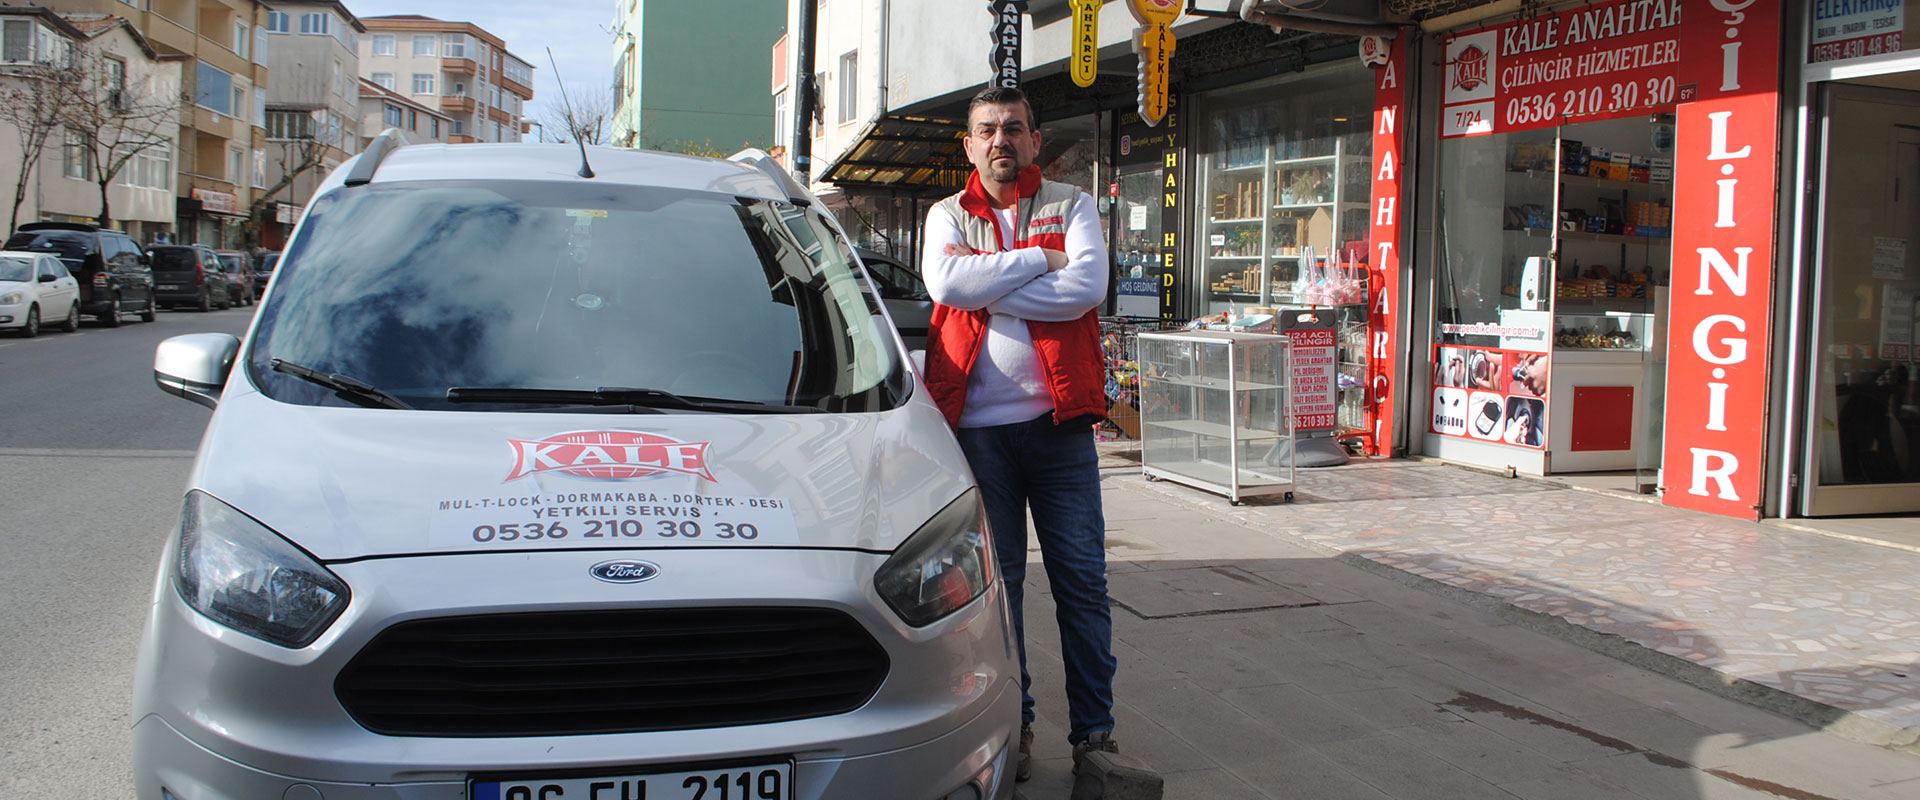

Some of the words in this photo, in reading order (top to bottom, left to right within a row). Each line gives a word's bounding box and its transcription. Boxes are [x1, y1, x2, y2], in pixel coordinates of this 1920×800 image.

[1002, 3, 1018, 88] ANAHTARC
[1083, 0, 1093, 73] AHTARCI
[1502, 17, 1560, 56] KALE
[1814, 43, 1840, 61] 0535
[1843, 40, 1864, 58] 430
[1868, 37, 1881, 55] 48
[1886, 34, 1900, 53] 96
[1455, 56, 1487, 86] KALE
[1502, 53, 1572, 93] ÇİLİNGİR
[1506, 92, 1557, 125] 0536
[1562, 86, 1603, 117] 210
[1608, 81, 1638, 112] 30
[1644, 76, 1675, 108] 30
[1456, 110, 1481, 128] 7/24
[1164, 94, 1178, 208] SEYHAN
[1373, 60, 1397, 447] ANAHTARCI
[1284, 416, 1301, 429] 036
[1303, 416, 1315, 427] 210
[1316, 415, 1325, 426] 30
[1326, 415, 1334, 426] 30
[518, 441, 705, 476] KALE
[439, 494, 541, 510] MUL-T-LOCK
[557, 493, 658, 504] DORMAKABA
[673, 494, 735, 507] DORTEK
[472, 522, 568, 542] 0536
[584, 520, 643, 538] 210
[657, 520, 701, 538] 30
[714, 522, 758, 540] 30
[606, 564, 645, 577] Ford
